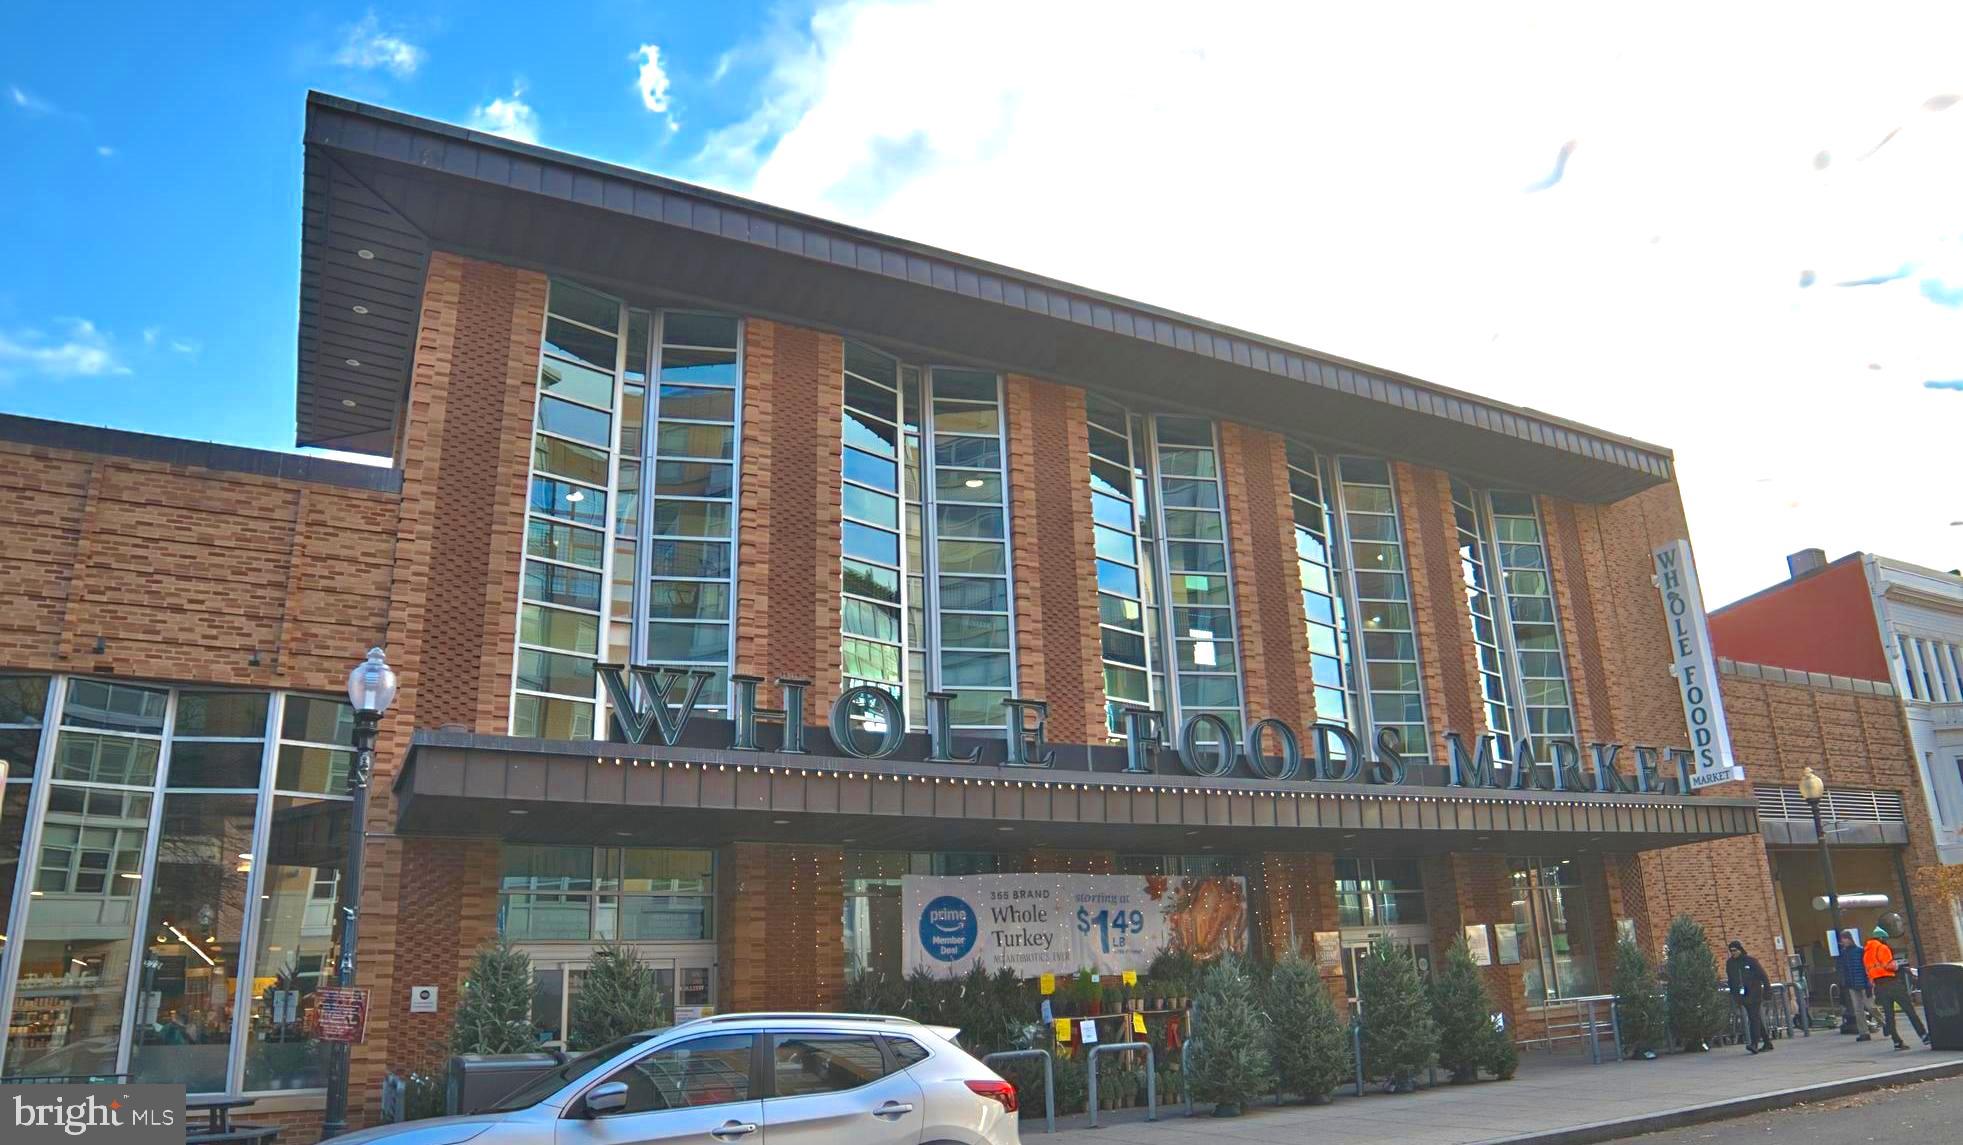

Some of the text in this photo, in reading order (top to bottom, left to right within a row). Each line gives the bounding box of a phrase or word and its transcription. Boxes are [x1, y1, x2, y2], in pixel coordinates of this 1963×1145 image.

[1656, 548, 1714, 769] WHOLE FOODS
[592, 663, 1695, 796] WHOLE FOODS MARKET
[1693, 770, 1731, 787] MARKET
[991, 889, 1050, 900] 365 BRAND
[930, 907, 967, 924] prime
[991, 904, 1048, 924] Whole
[932, 935, 966, 945] Member
[991, 928, 1054, 950] Turkey
[1113, 936, 1126, 948] LB
